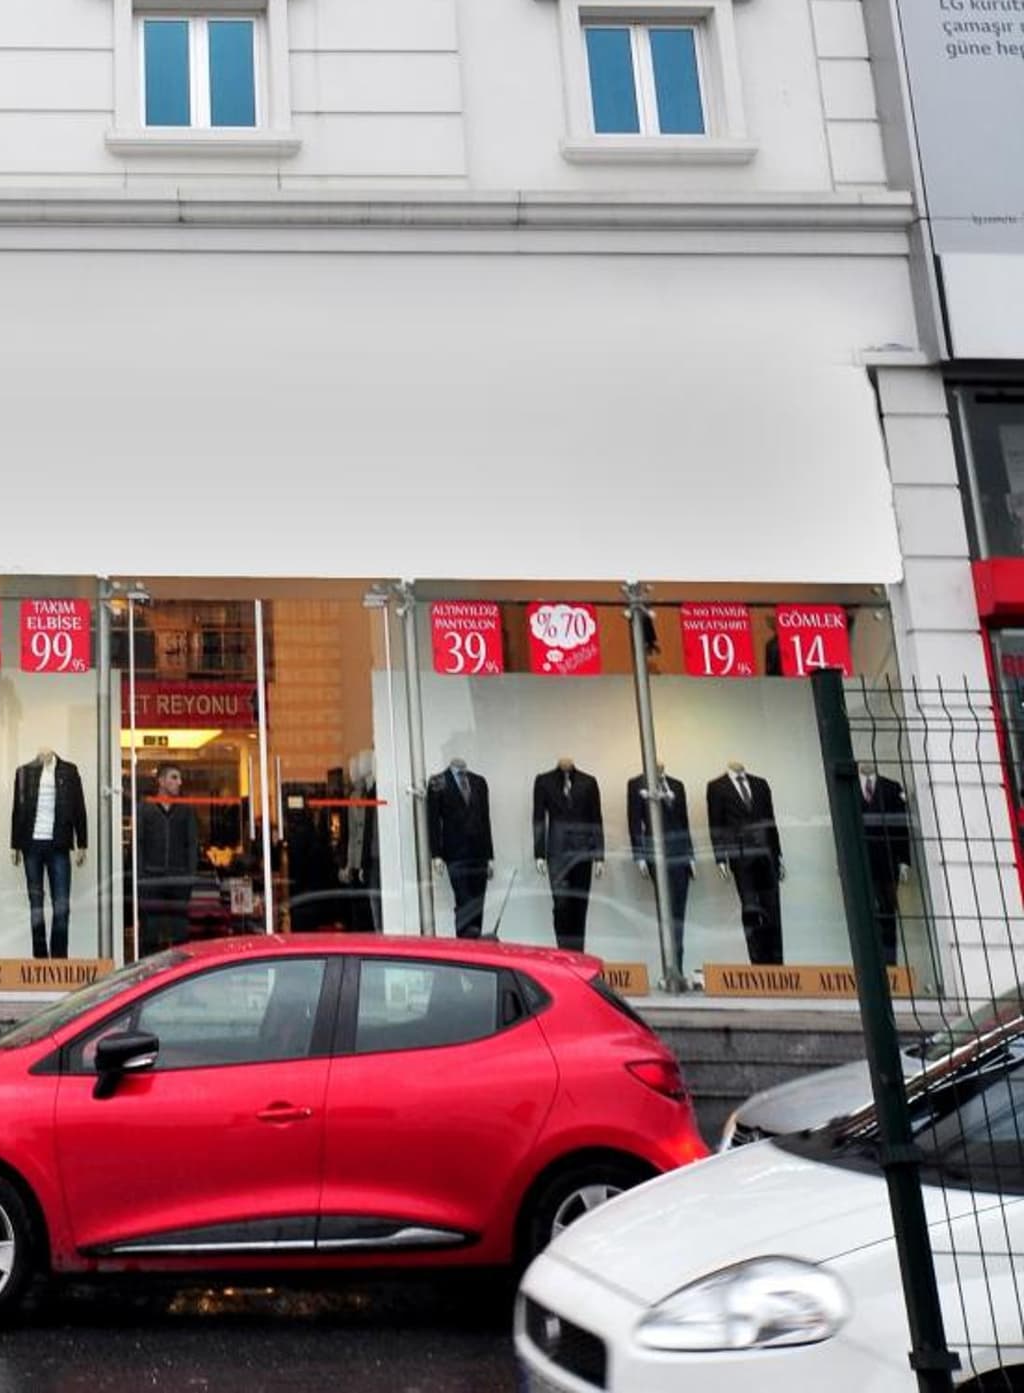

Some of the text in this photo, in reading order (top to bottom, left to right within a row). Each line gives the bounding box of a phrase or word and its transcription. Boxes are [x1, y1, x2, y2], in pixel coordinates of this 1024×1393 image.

[942, 21, 1013, 36] çamaşır
[946, 42, 991, 59] güne
[32, 600, 75, 614] TAKIM
[27, 614, 82, 630] ELBİSE
[434, 617, 496, 630] PANTOLON
[683, 620, 747, 632] SWEATSHIRT
[778, 611, 845, 629] GÖMLEK
[791, 634, 828, 676] 14
[157, 694, 239, 716] REYONU
[722, 971, 802, 991] ALTINYILDIZ
